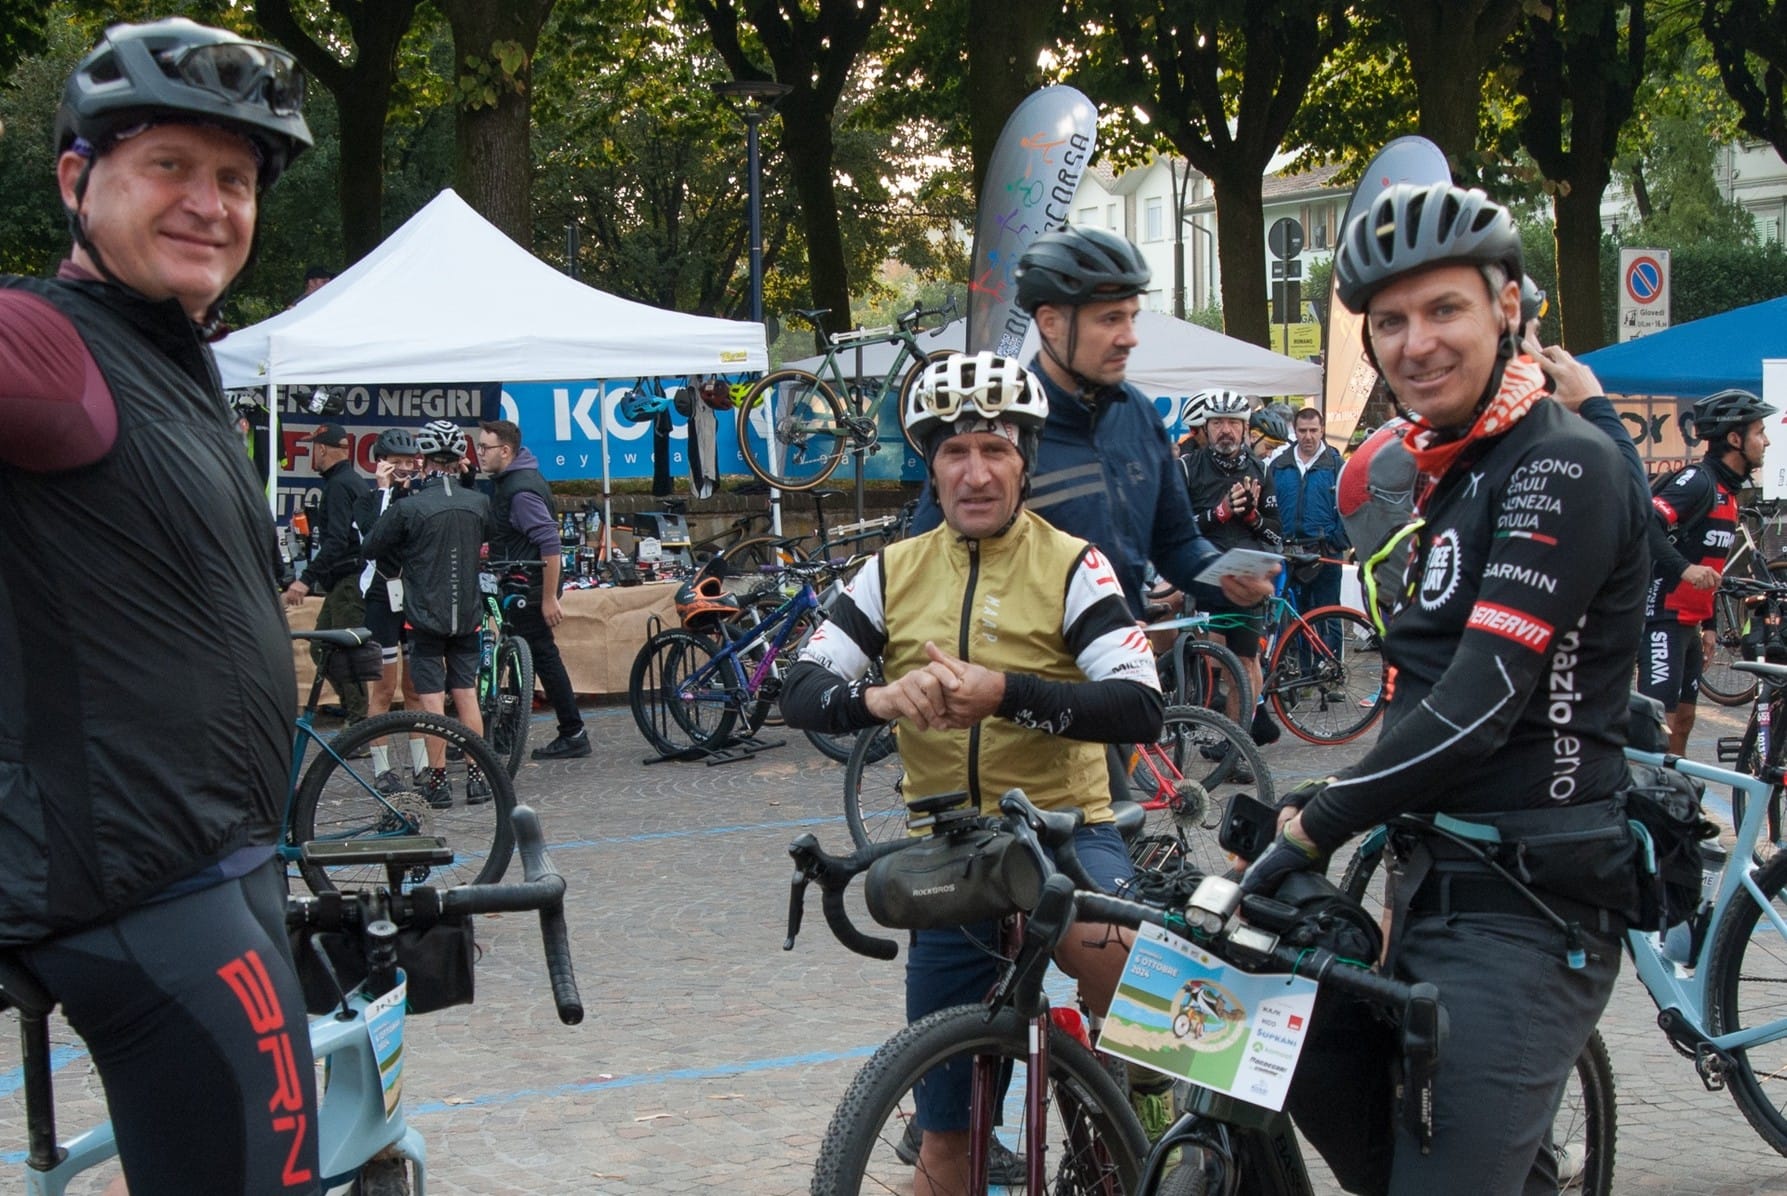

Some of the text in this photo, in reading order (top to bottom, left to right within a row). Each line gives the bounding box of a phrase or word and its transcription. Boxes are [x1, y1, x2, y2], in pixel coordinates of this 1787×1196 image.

[378, 387, 482, 418] NEGRI
[1531, 458, 1583, 479] SONO
[1651, 631, 1670, 685] STRAVA
[414, 721, 467, 743] MAXXIS
[1142, 958, 1179, 978] OTTOBRE
[216, 948, 313, 1187] BRN
